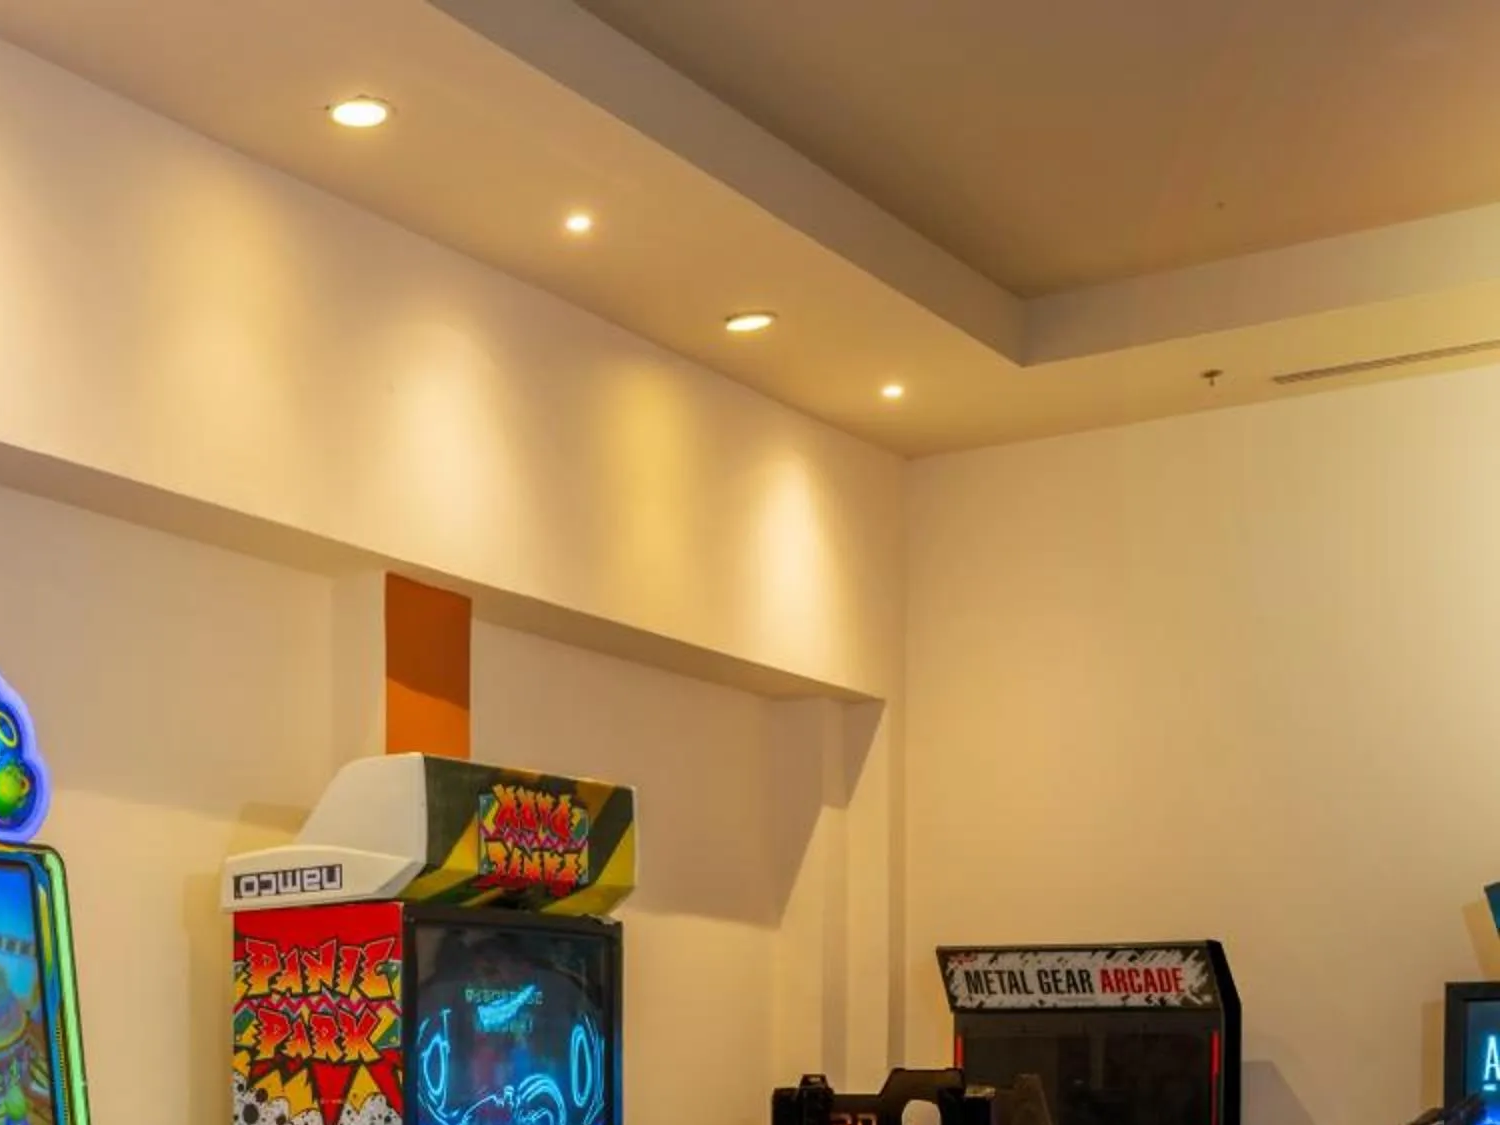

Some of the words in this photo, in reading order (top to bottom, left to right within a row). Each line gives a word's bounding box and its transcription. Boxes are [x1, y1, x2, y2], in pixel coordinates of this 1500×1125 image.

[240, 865, 341, 897] namco
[245, 936, 395, 998] PANIC
[964, 969, 1034, 995] METAL
[1037, 968, 1094, 995] GEAR
[1100, 966, 1186, 994] ARCADE
[257, 1005, 382, 1062] PARK
